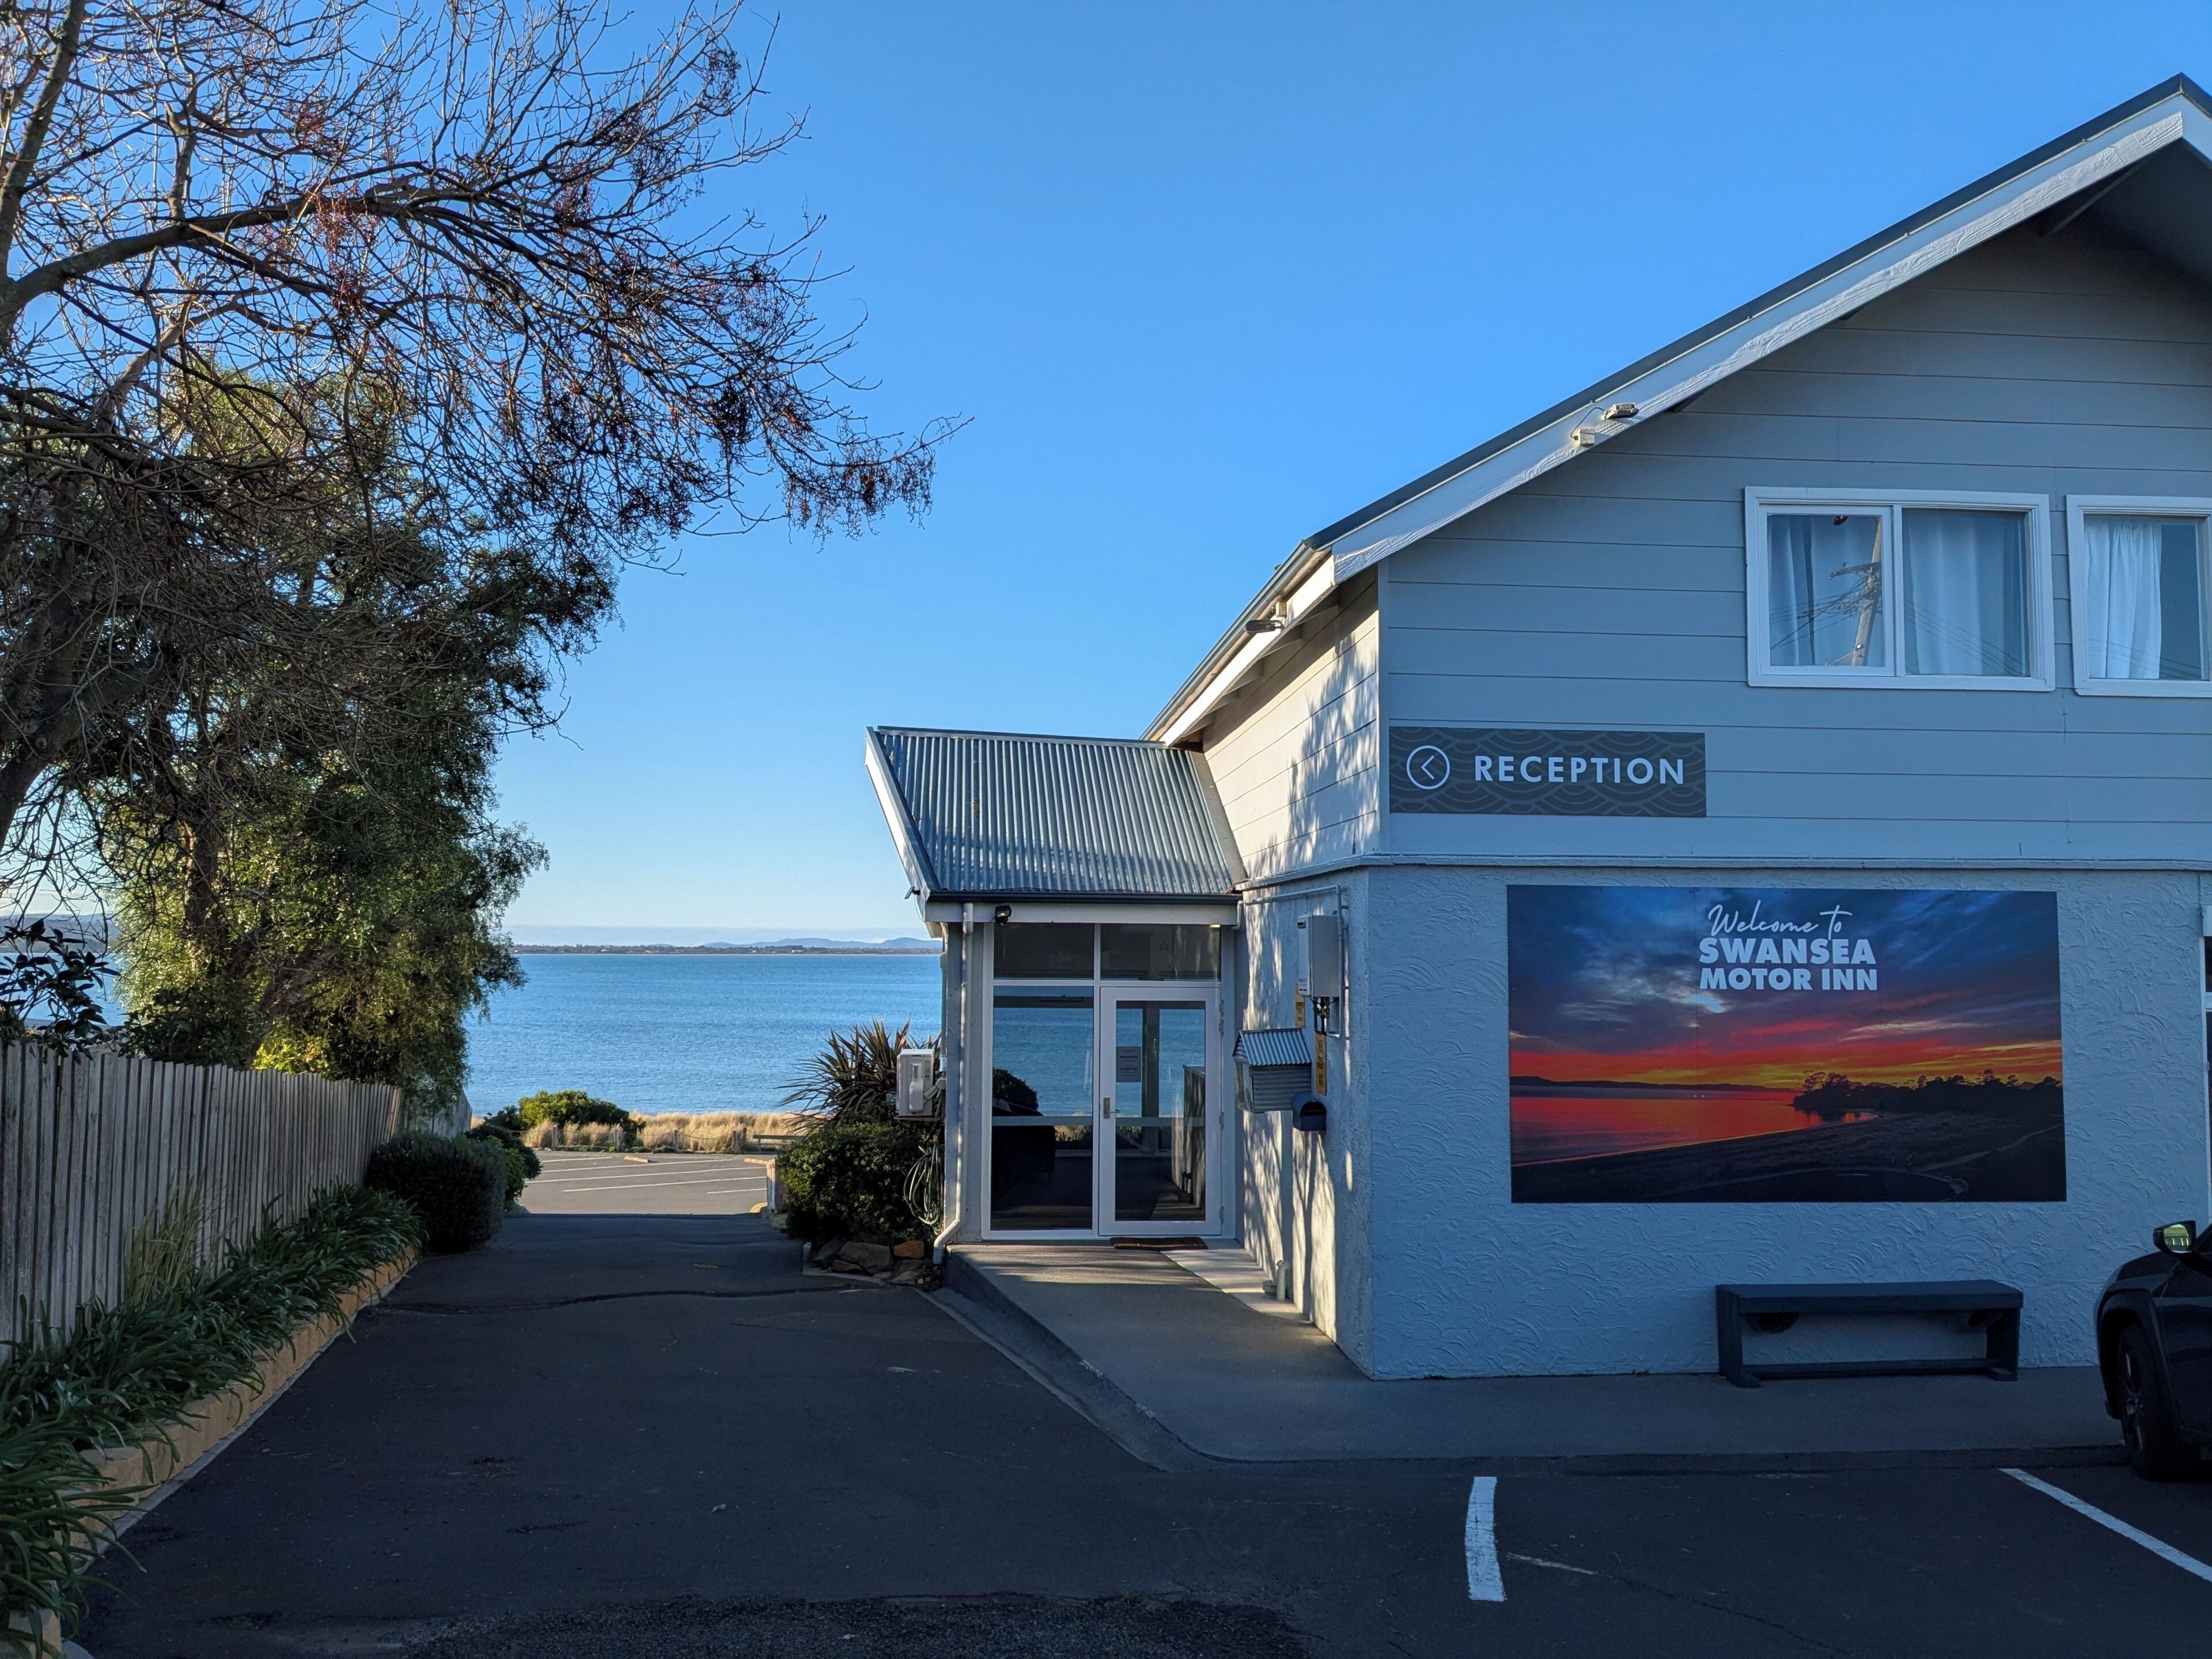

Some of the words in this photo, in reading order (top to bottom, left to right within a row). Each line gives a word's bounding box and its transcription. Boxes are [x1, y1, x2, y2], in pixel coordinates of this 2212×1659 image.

[1475, 755, 1684, 784] RECEPTION
[1708, 899, 1819, 937] Welcome
[1820, 904, 1853, 941] to
[1699, 938, 1876, 964] SWANSEA
[1699, 968, 1812, 990] MOTOR
[1821, 969, 1877, 990] INN
